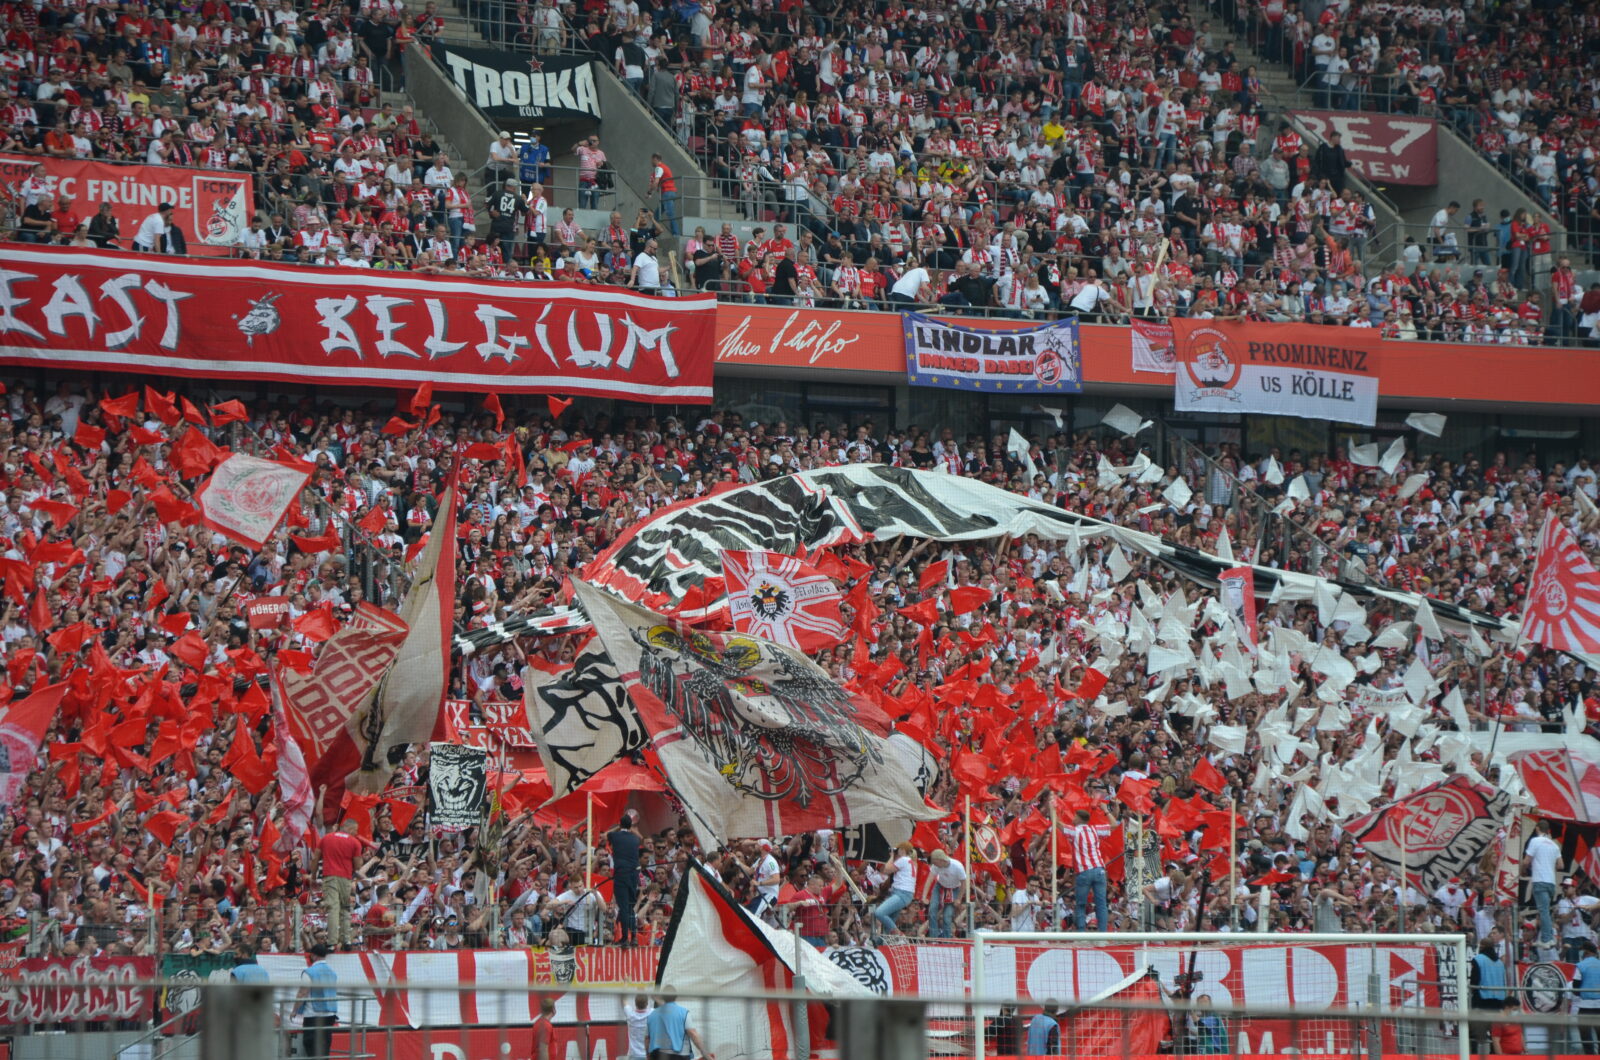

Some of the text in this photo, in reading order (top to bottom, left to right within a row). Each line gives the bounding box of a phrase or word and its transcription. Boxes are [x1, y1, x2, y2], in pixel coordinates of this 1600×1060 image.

[446, 51, 601, 119] TROIKA
[519, 105, 544, 117] KÖLN
[1, 163, 31, 177] CFM
[1351, 159, 1411, 178] REW
[87, 176, 193, 209] FRÜNDE
[203, 182, 238, 194] FCFM
[500, 196, 516, 214] 64
[0, 268, 681, 378] EAST BELGIUM
[917, 326, 1036, 356] LINDLAR
[1248, 340, 1369, 372] PROMINENZ
[918, 352, 1035, 376] IMMER DABEI
[1260, 371, 1355, 402] US KÖLLE
[250, 603, 279, 616] HÖHER
[1408, 801, 1443, 841] 1.FC
[1431, 815, 1465, 845] KÖLN
[535, 951, 552, 985] SEK
[918, 944, 1426, 1020] HORDE
